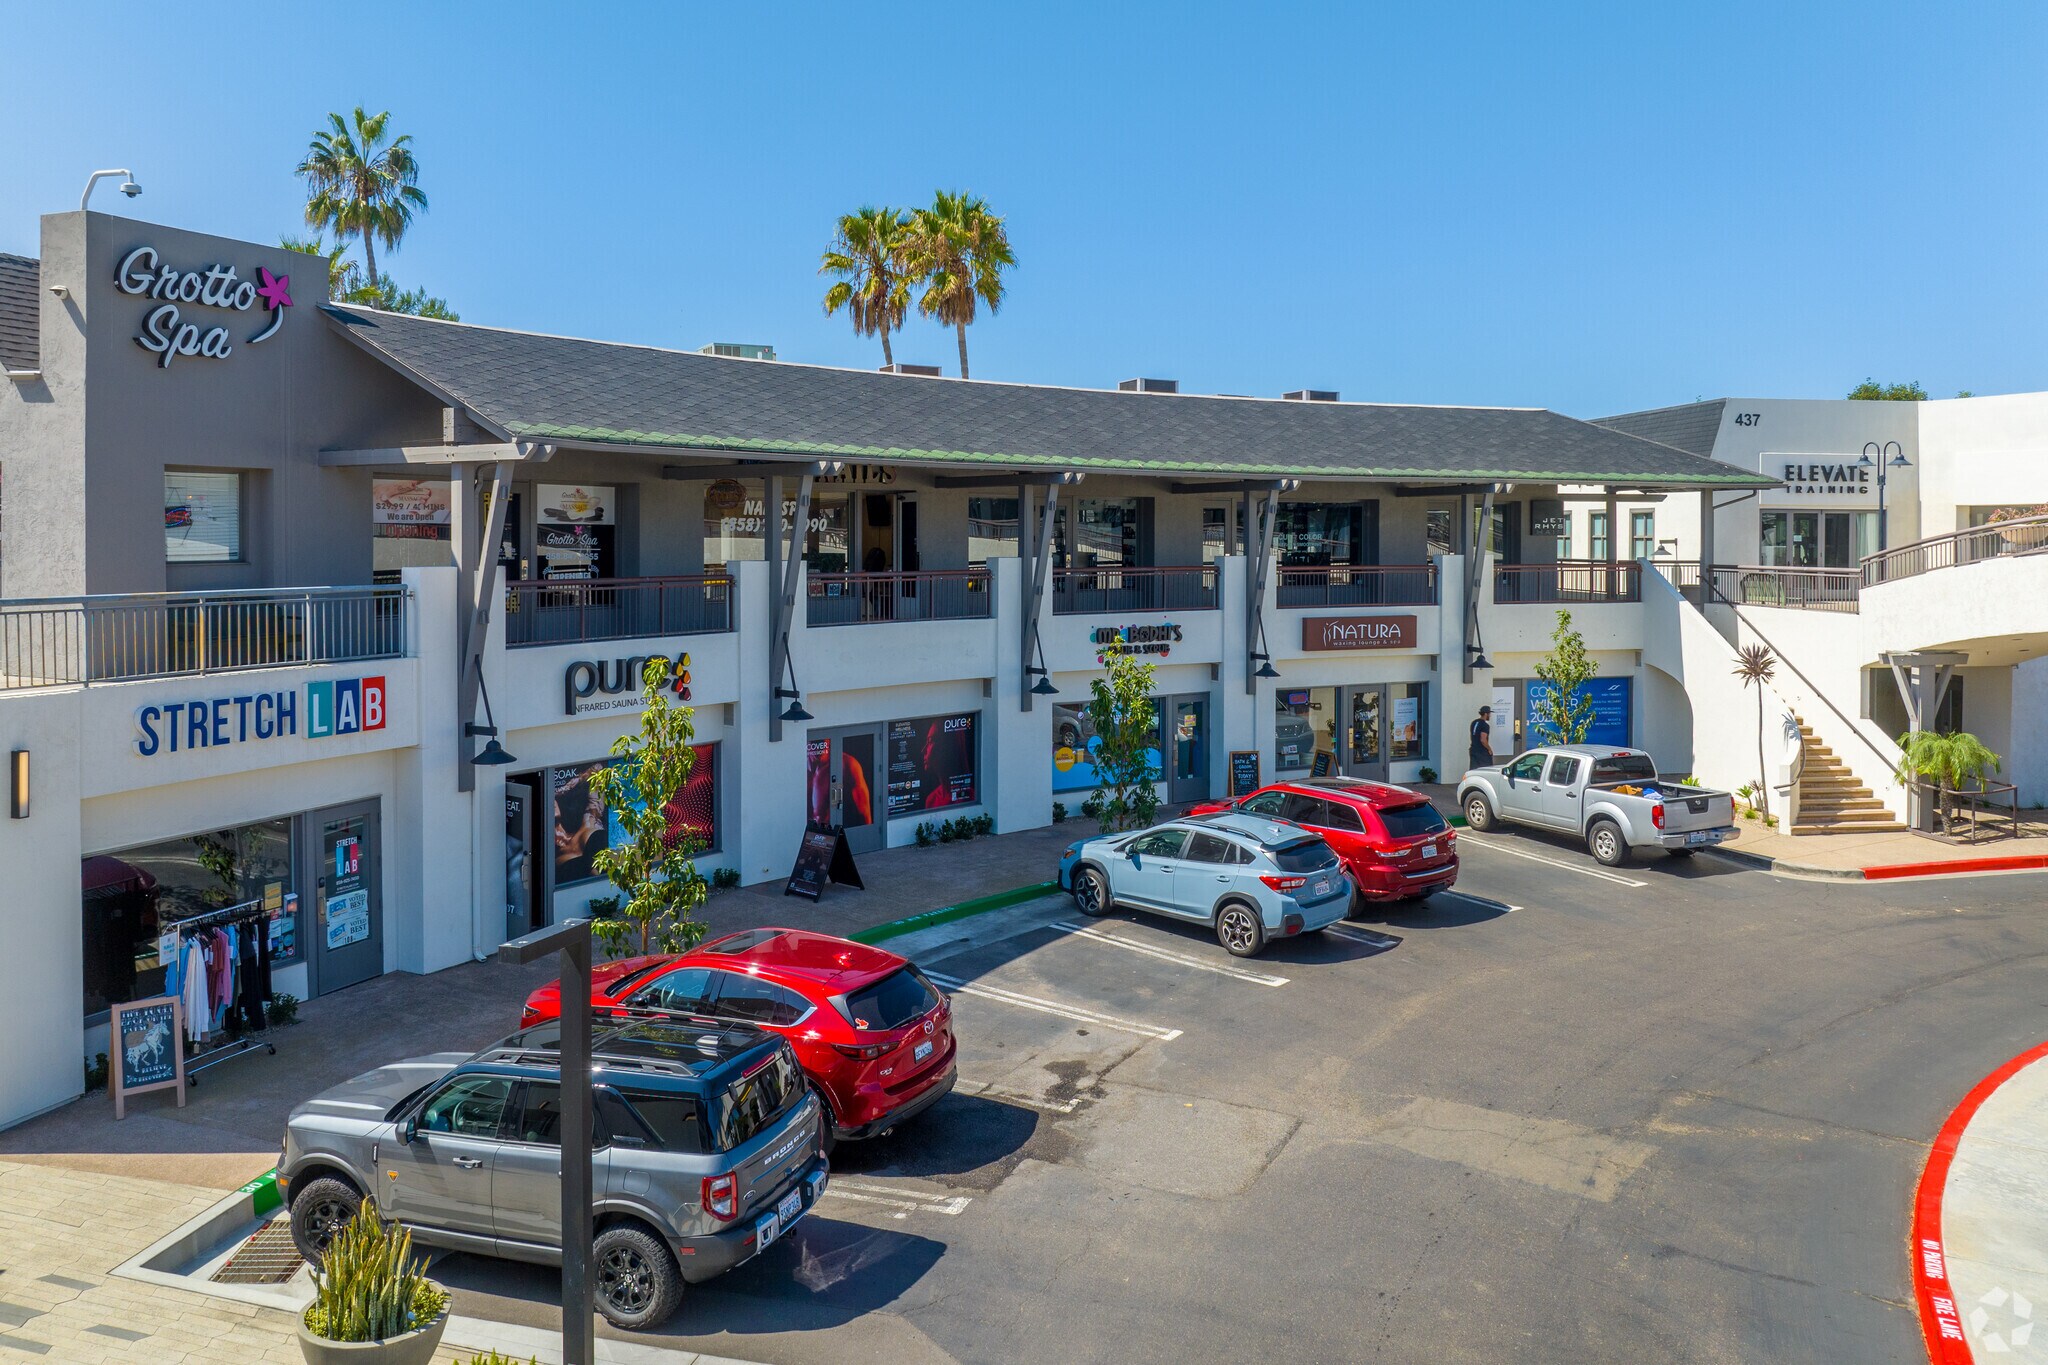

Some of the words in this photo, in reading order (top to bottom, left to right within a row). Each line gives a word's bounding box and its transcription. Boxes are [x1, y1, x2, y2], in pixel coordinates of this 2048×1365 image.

[115, 246, 257, 311] Grotto
[132, 303, 232, 369] Spa
[1735, 413, 1761, 426] 437
[1784, 464, 1869, 483] ELEVATE
[1786, 485, 1869, 494] TRAINING
[423, 503, 446, 511] MINS
[387, 513, 400, 521] We
[415, 513, 435, 522] Open
[385, 524, 439, 541] Opening
[546, 533, 575, 546] Grotto
[579, 533, 599, 548] Spa
[1298, 533, 1323, 541] COLOR
[1333, 623, 1401, 640] NATURA
[575, 699, 611, 714] NFRARED
[611, 697, 639, 709] SAUNA
[135, 690, 297, 757] STRETCH
[306, 681, 385, 737] LAB
[944, 717, 967, 732] pure
[336, 836, 358, 848] STRETCH
[336, 859, 359, 876] LAB
[329, 899, 348, 914] BEST
[348, 894, 367, 903] VOTED
[350, 901, 366, 910] BEST
[329, 924, 347, 939] BEST
[349, 923, 368, 936] BEST
[764, 1130, 806, 1165] BRONCO
[241, 1181, 263, 1193] 30
[1922, 1239, 1940, 1250] NO
[1923, 1249, 1944, 1280] PARKING
[1932, 1296, 1956, 1316] FIRE
[1938, 1317, 1964, 1341] LANE
